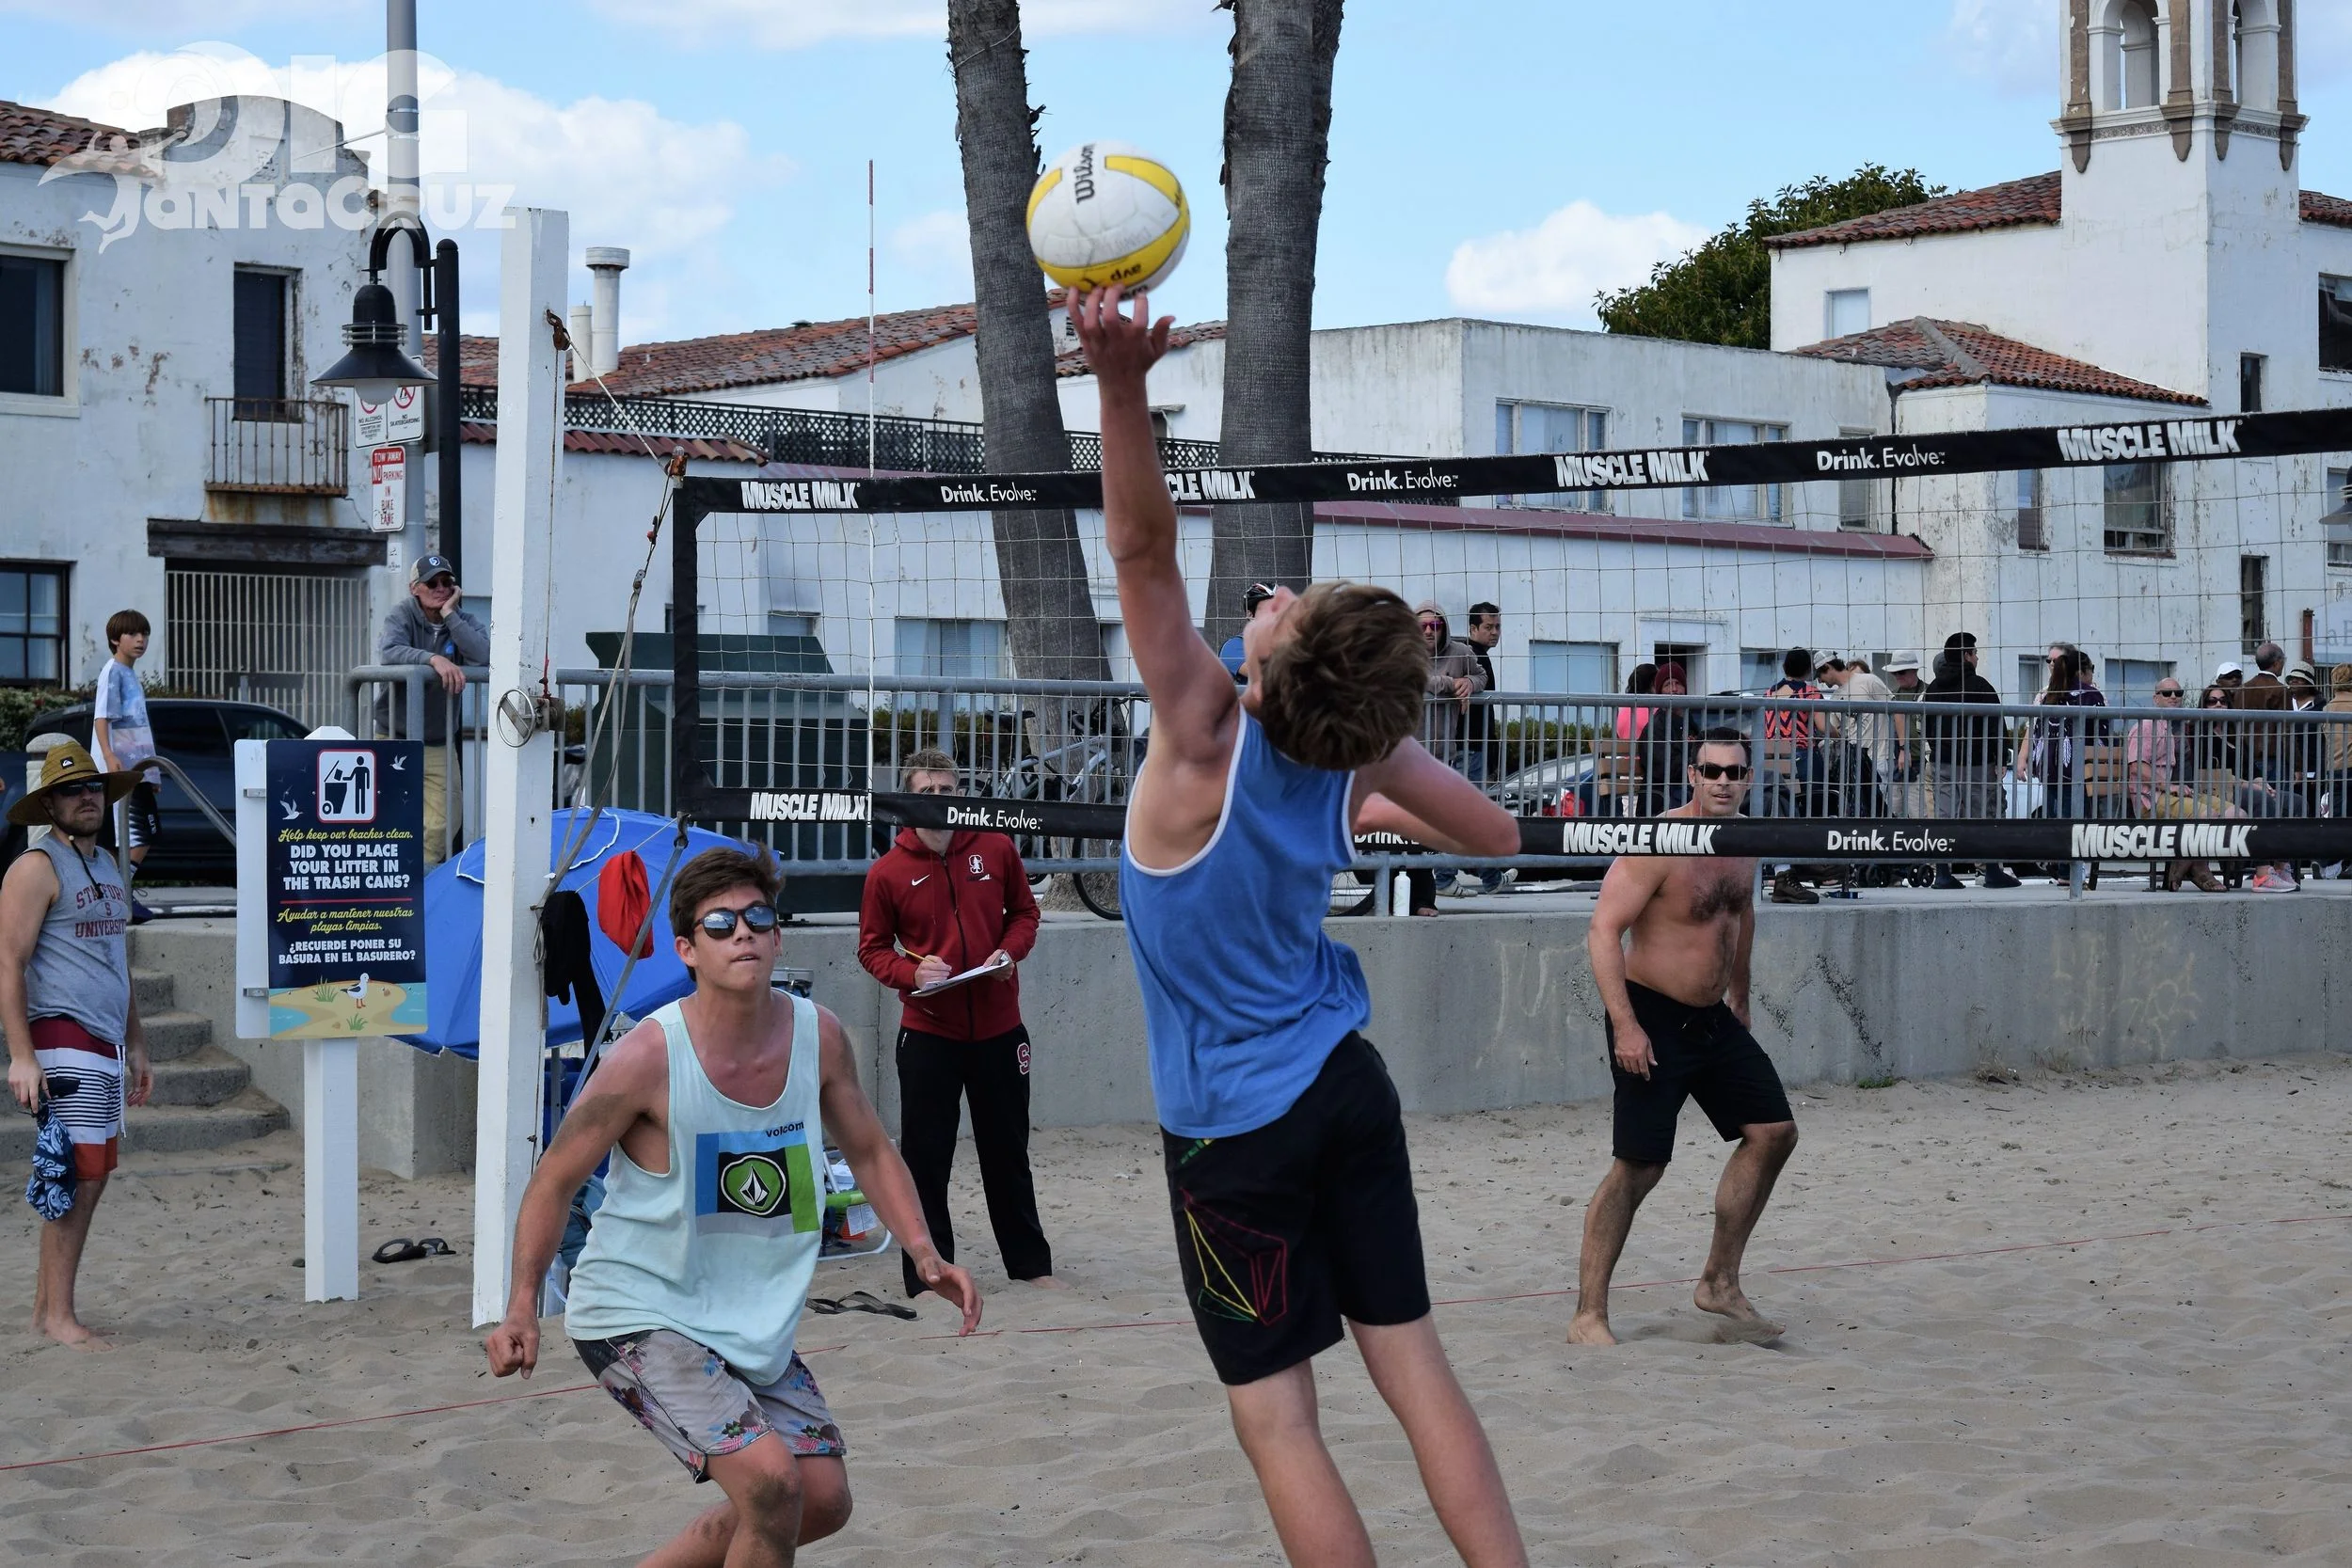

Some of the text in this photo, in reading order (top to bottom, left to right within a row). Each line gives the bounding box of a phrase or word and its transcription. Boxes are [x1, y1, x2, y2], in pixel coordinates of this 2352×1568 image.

[2057, 424, 2167, 462] MUSCLE
[1817, 447, 1880, 470] Drink.
[373, 465, 404, 482] NO PARKING
[1347, 469, 1403, 491] Drink.
[1554, 454, 1646, 487] MUSCLE
[385, 485, 391, 497] IN
[740, 481, 811, 510] MUSCLE
[941, 483, 989, 502] Drink.
[1165, 473, 1201, 502] CLE
[750, 792, 818, 820] MUSCLE
[946, 806, 993, 827] Drink.
[278, 828, 414, 842] Help keep our beaches clean.
[1564, 821, 1653, 854] MUSCLE
[1827, 829, 1889, 851] Drink.
[2072, 823, 2177, 858] MUSCLE
[290, 844, 398, 858] DID YOU PLACE
[290, 860, 399, 874] YOUR LITTER IN
[283, 874, 410, 890] THE TRASH CANS?
[277, 908, 319, 923] Ayudar
[329, 908, 373, 919] mantener
[373, 907, 414, 917] nuestras
[75, 918, 126, 938] UNIVERSIT
[310, 920, 382, 934] playas limpias.
[289, 939, 402, 954] ¿RECUERDE PONER SU
[278, 950, 416, 965] BASURA EN EL BASURERO?
[766, 1120, 804, 1138] volcom
